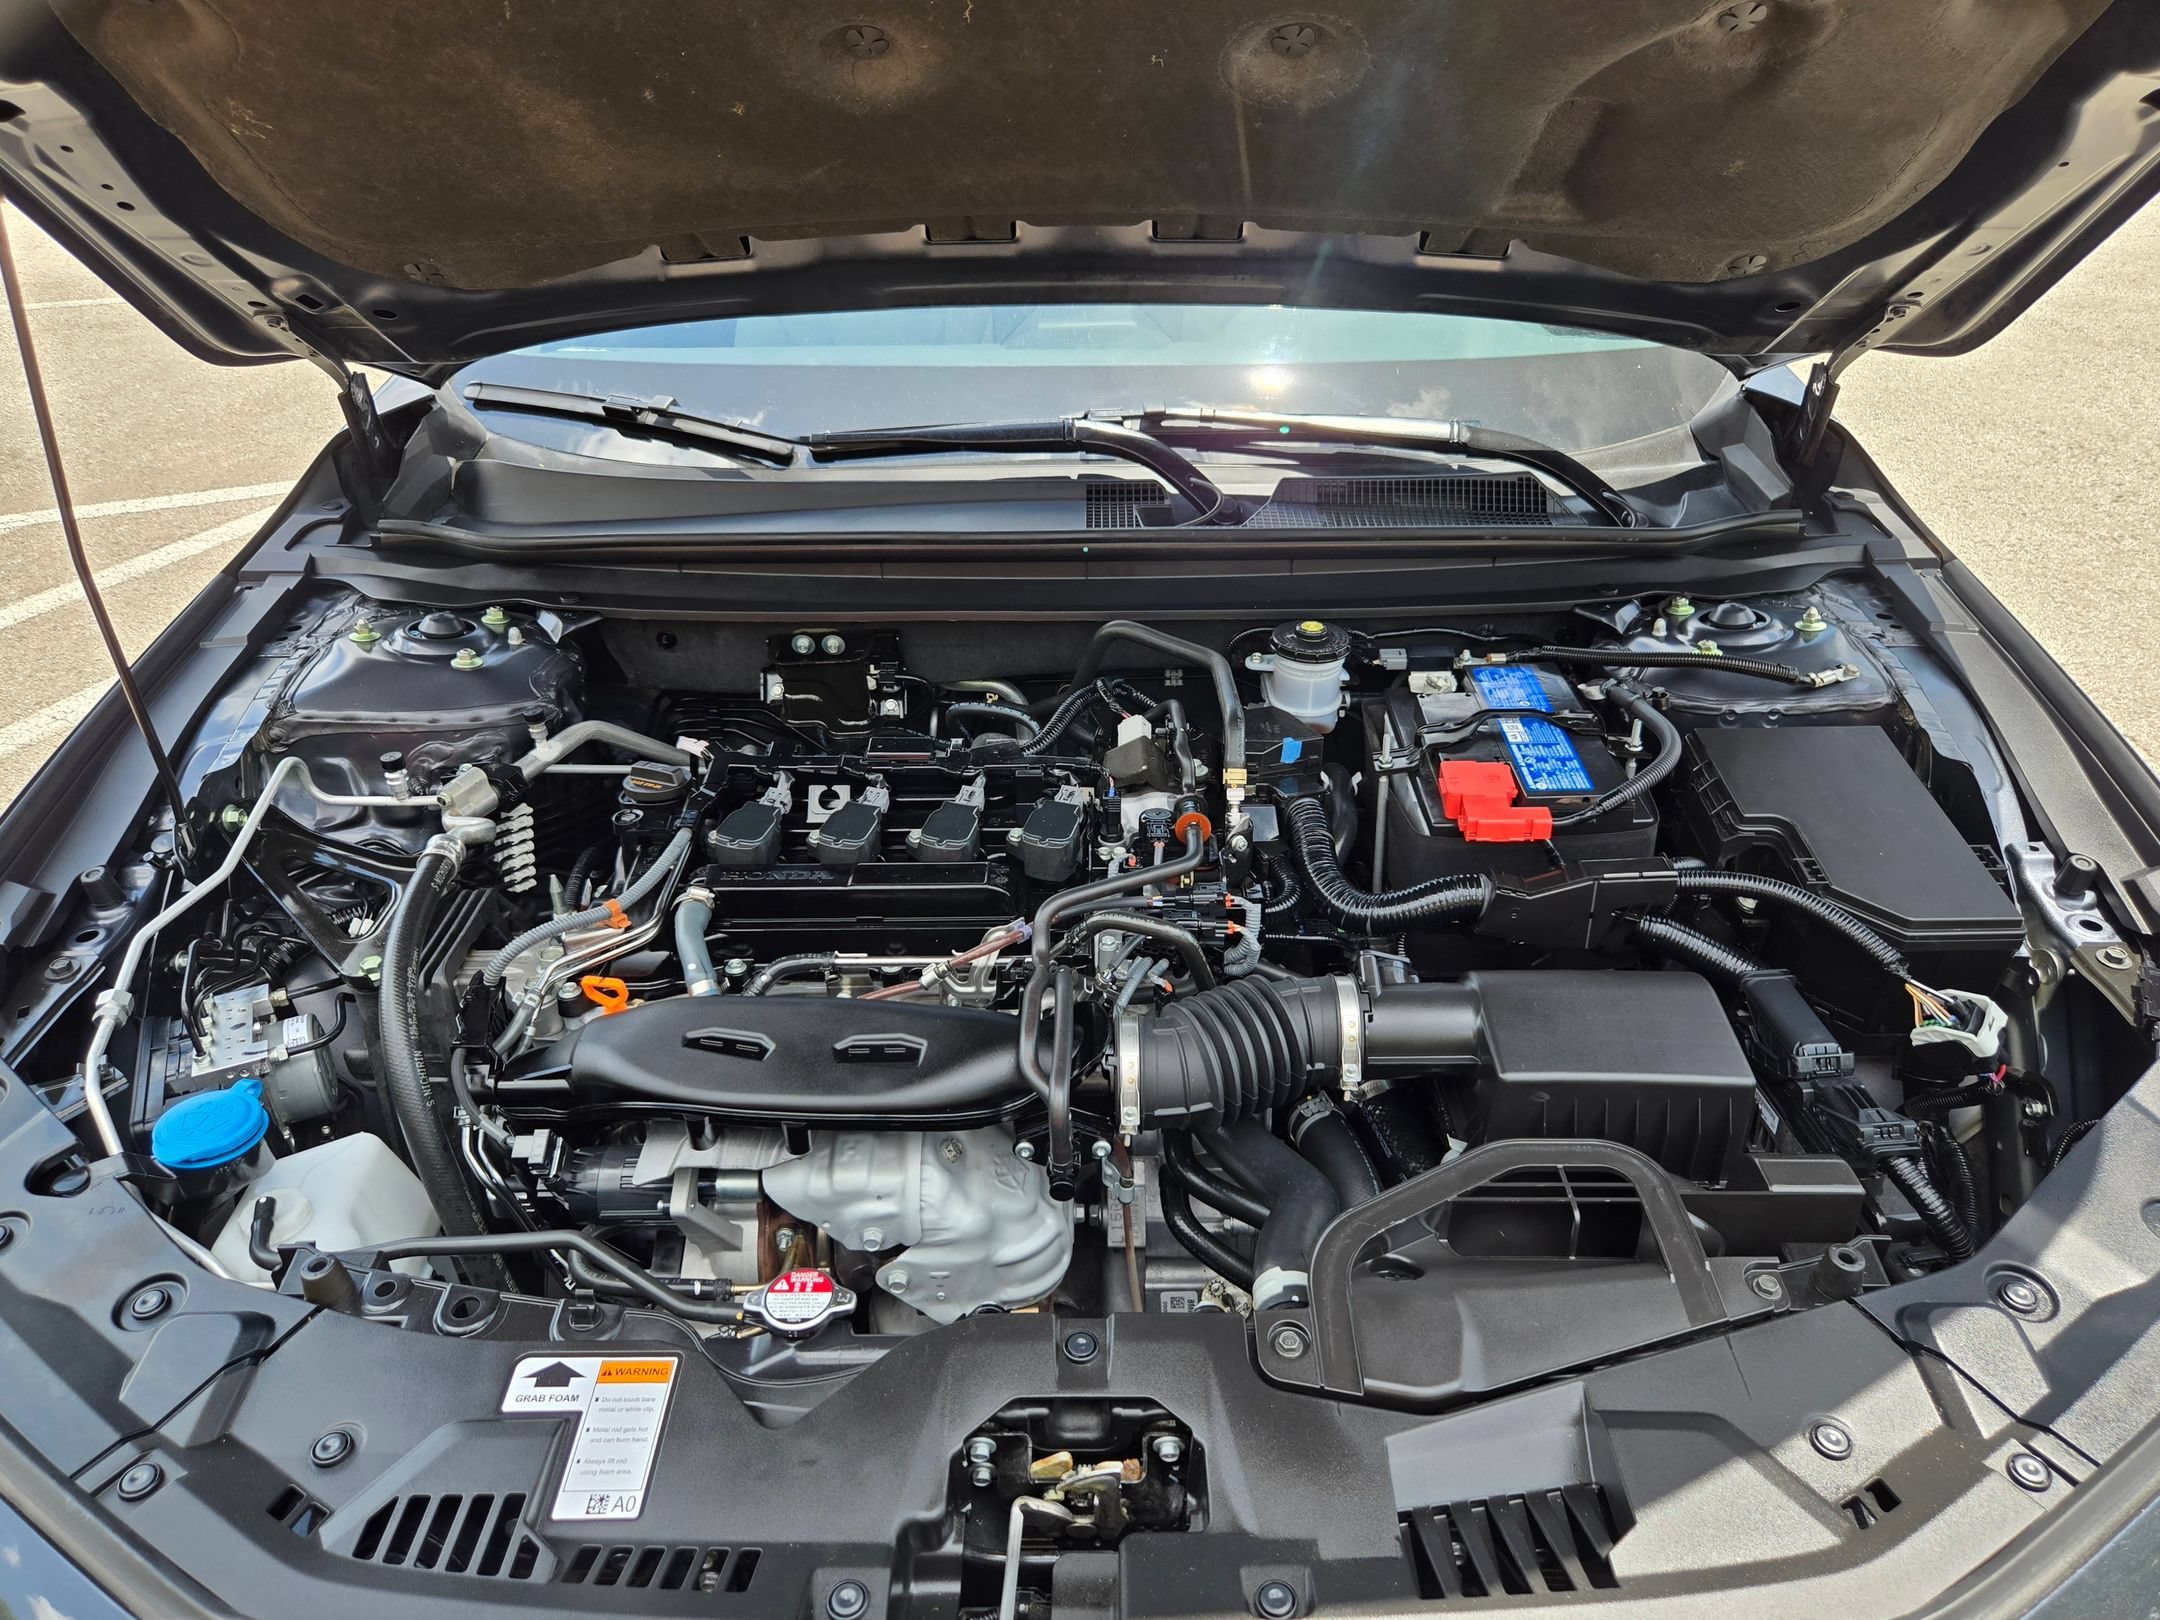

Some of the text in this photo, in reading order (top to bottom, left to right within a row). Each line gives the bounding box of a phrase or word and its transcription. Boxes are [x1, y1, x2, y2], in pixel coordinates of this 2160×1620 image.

[720, 870, 835, 881] HONDA
[615, 1367, 669, 1376] WARNING
[515, 1394, 580, 1403] GRAB FOAM
[583, 1457, 606, 1465] Always
